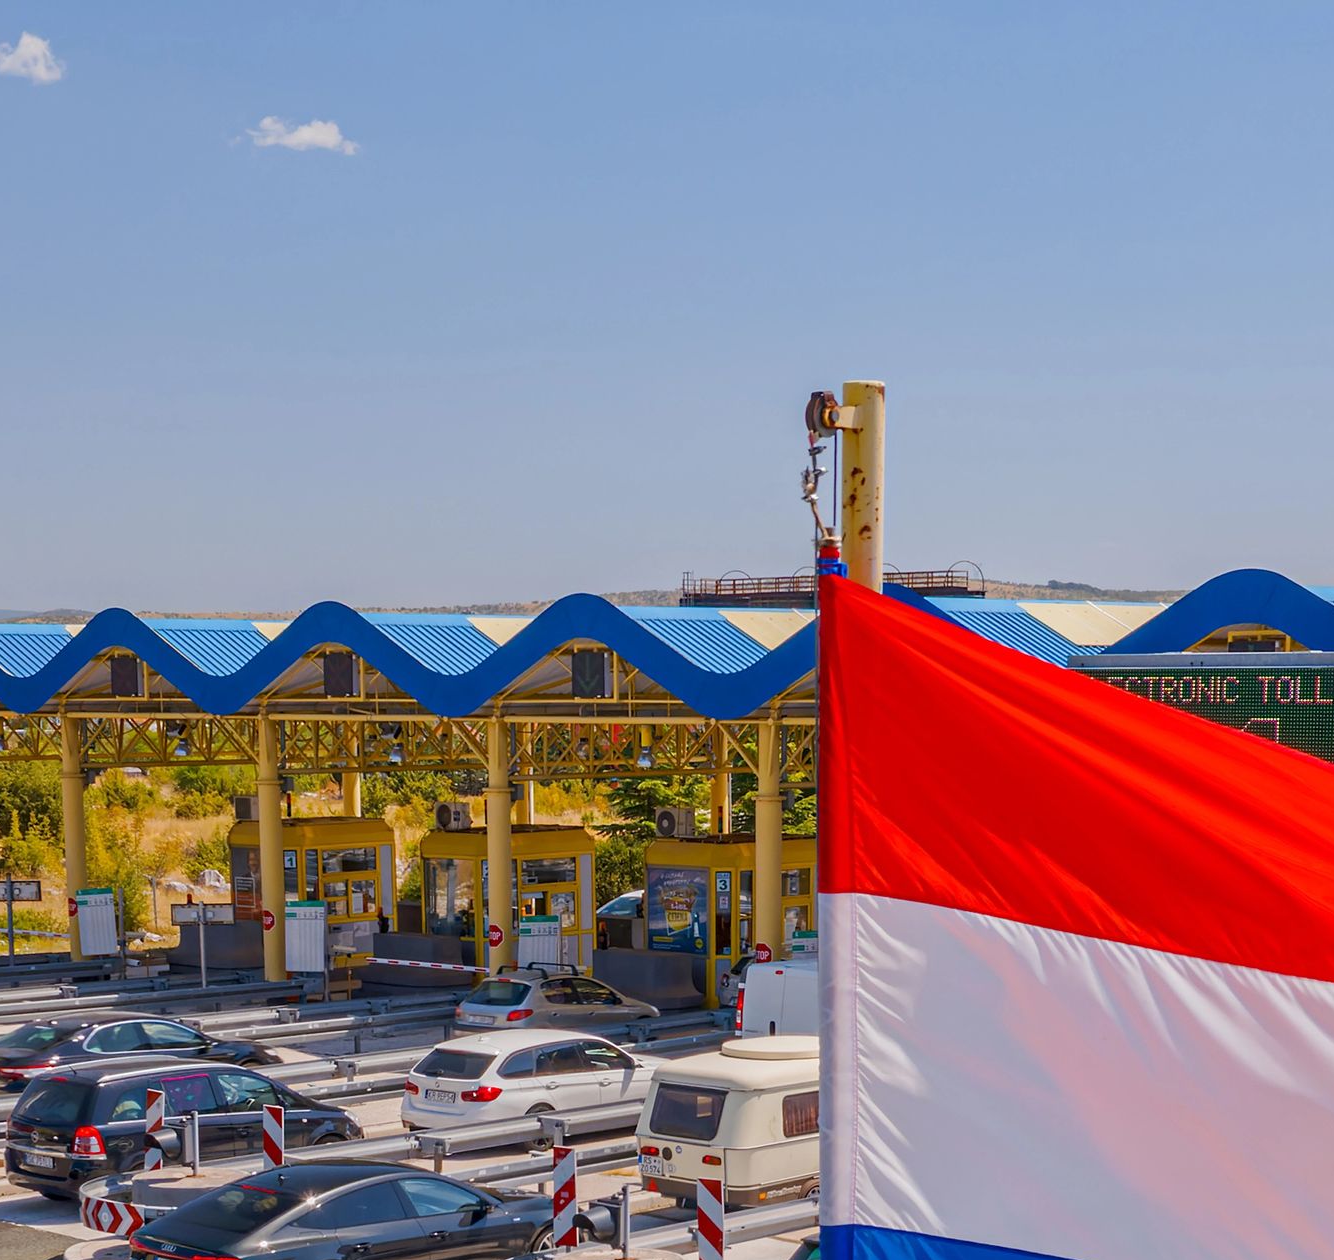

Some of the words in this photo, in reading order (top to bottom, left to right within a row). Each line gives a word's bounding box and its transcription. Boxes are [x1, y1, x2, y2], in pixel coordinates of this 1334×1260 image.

[1107, 676, 1240, 704] CTRONIC
[1258, 675, 1334, 704] TOLL
[719, 879, 728, 891] 3
[757, 951, 770, 960] TOP
